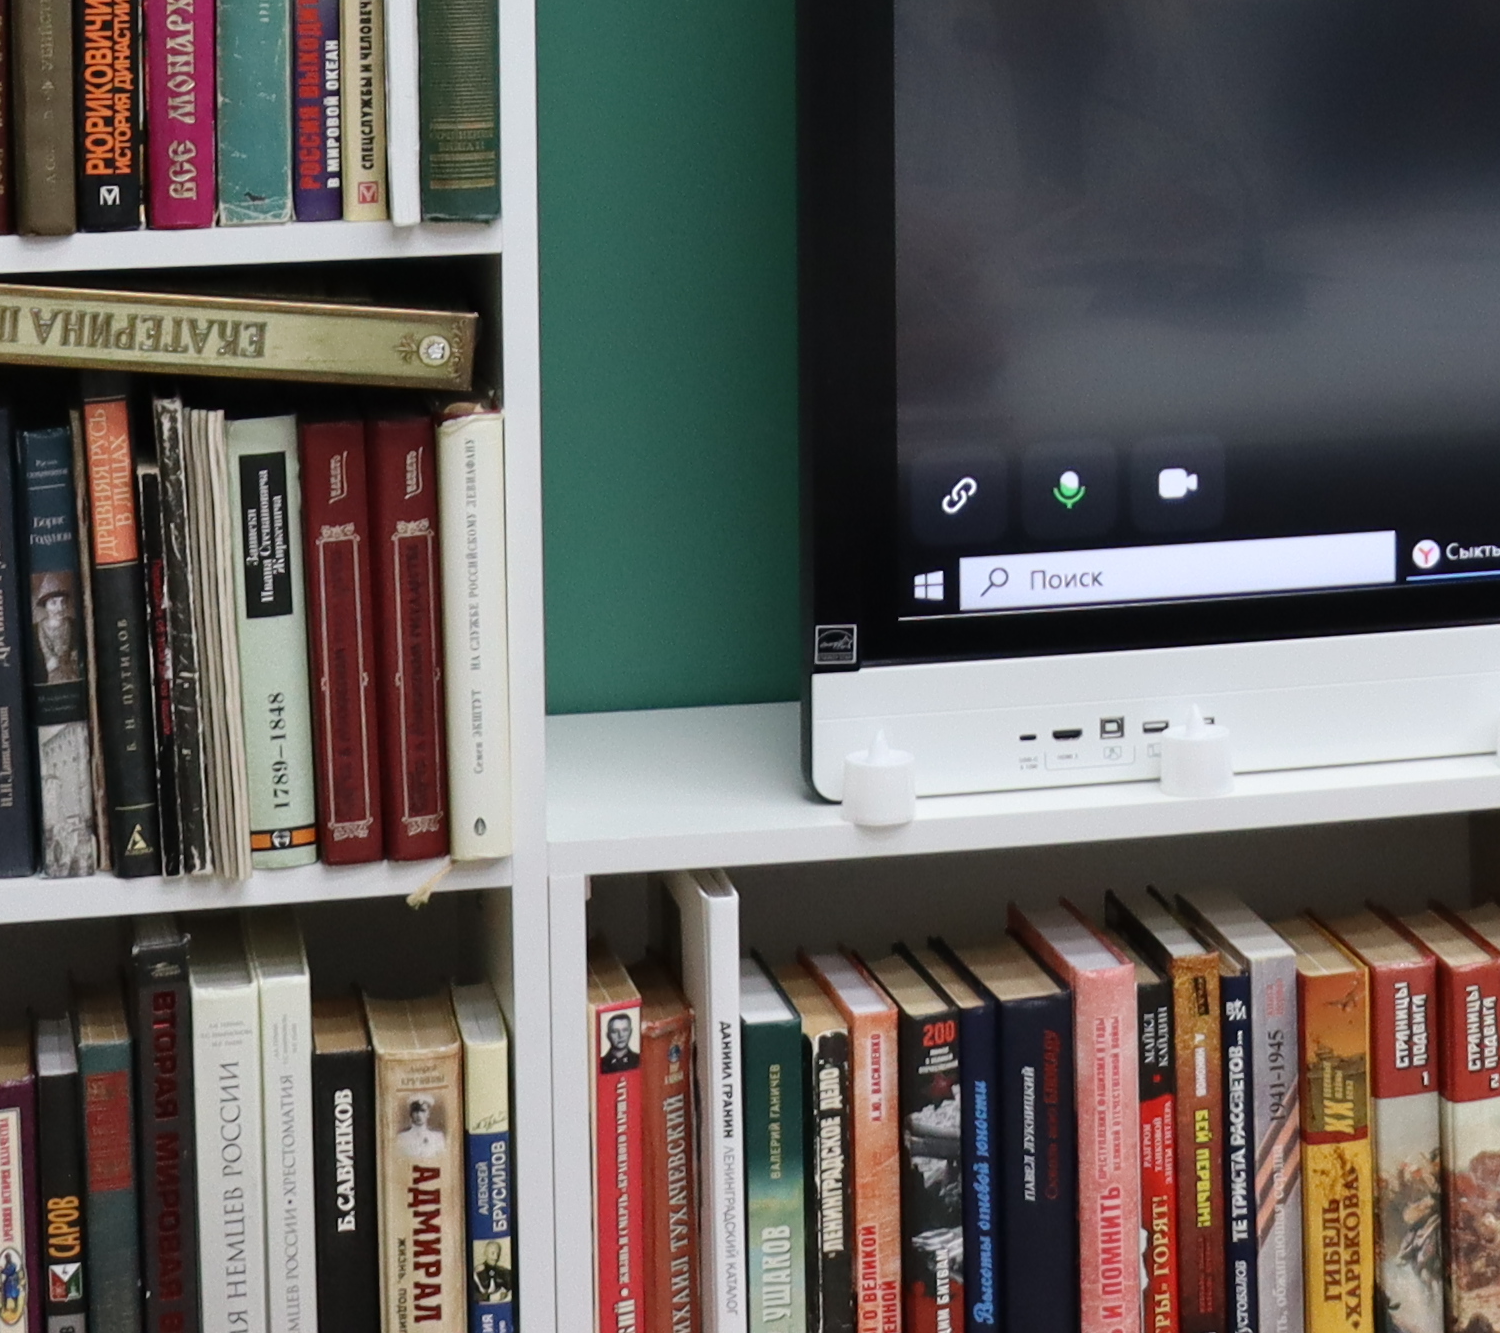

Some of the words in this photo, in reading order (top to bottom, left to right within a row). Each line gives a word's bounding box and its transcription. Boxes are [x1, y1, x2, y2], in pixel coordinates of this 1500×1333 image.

[168, 140, 197, 200] ВСЕ
[30, 307, 267, 357] ЕКАТЕРИНА
[1029, 567, 1104, 592] Поиск
[219, 1060, 244, 1177] РОССИИ
[336, 1088, 357, 1231] Б.САВИНКОВ
[819, 1116, 844, 1251] ЛЕНИНГРАДСКОЕ
[222, 1185, 249, 1299] НЕМЦЕВ
[761, 1226, 791, 1322] УШАКОВ
